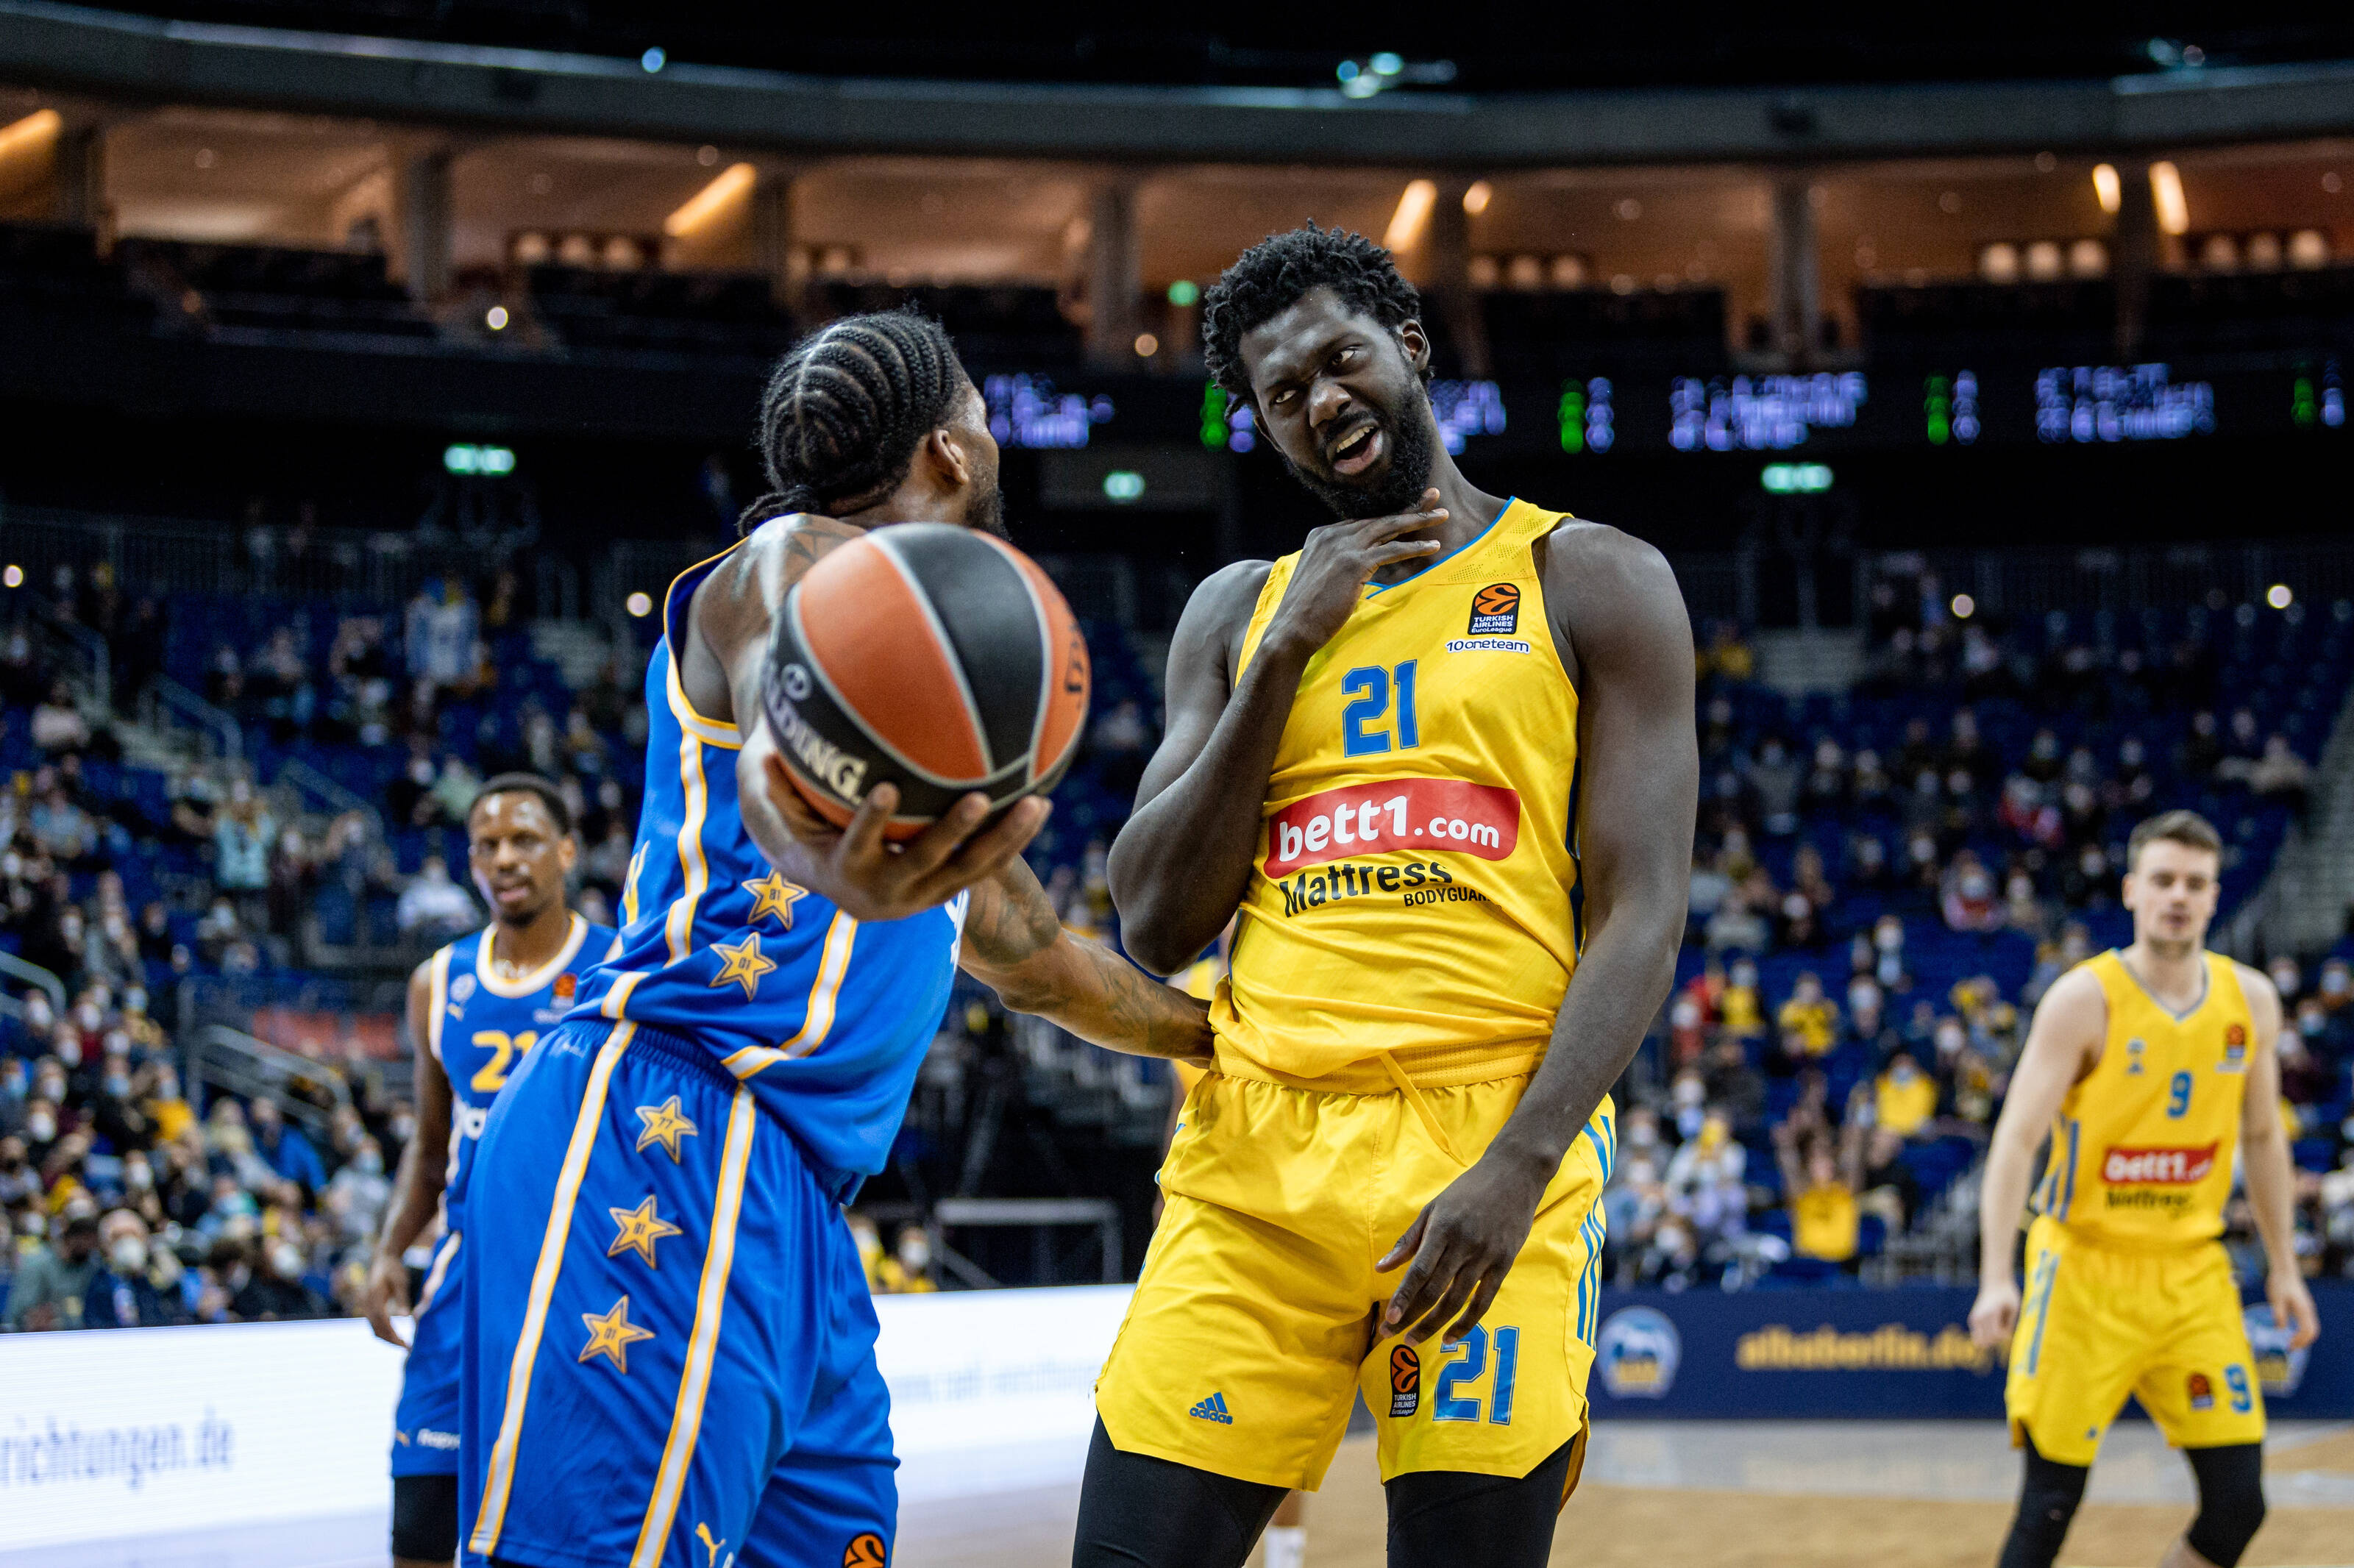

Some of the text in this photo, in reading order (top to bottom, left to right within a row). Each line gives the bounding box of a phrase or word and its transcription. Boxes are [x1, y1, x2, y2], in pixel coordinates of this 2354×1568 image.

[1341, 659, 1419, 758] 21
[1279, 795, 1499, 862] bett1.com
[1279, 861, 1453, 918] Mattress
[2166, 1070, 2193, 1119] 9
[1394, 1392, 1417, 1401] TURKISH
[1432, 1322, 1521, 1425] 21
[2223, 1363, 2253, 1414] 9
[1189, 1407, 1234, 1425] adidas
[1393, 1400, 1416, 1408] AIRLINES
